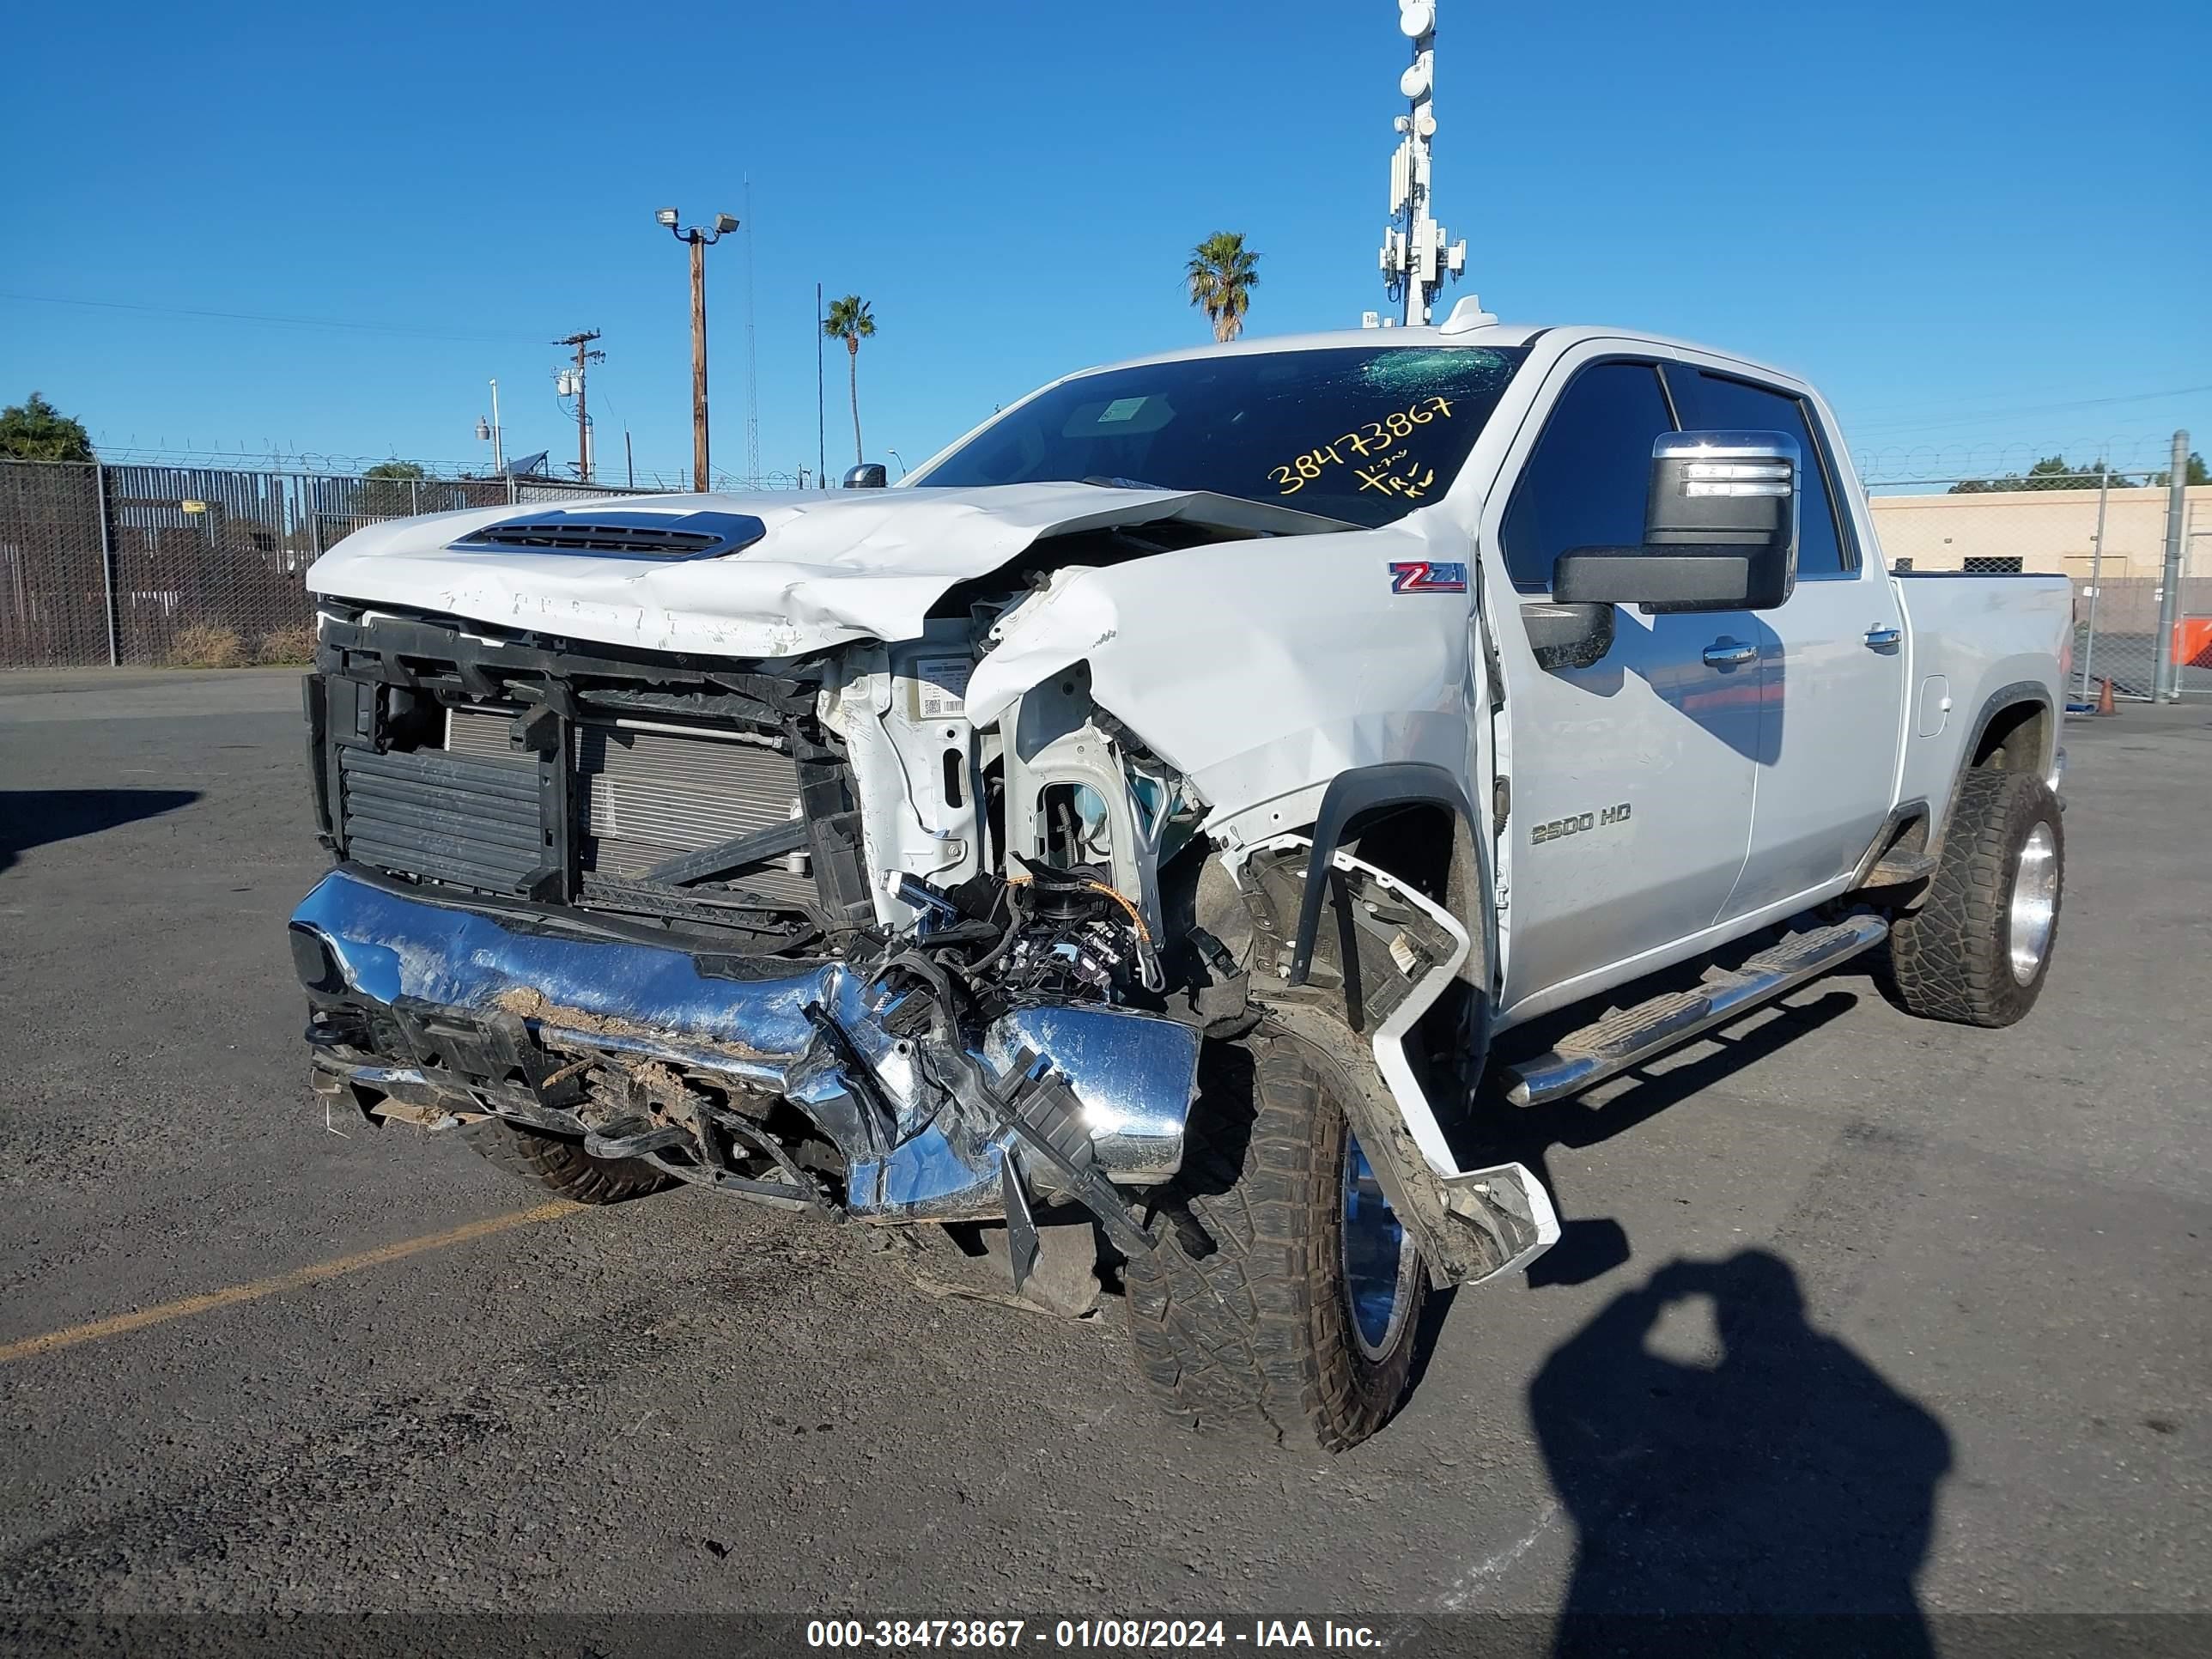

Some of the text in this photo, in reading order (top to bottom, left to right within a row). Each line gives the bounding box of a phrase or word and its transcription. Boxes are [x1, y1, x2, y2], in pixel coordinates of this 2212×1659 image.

[1267, 396, 1454, 495] 38473867
[1529, 802, 1632, 846] 2500 HD
